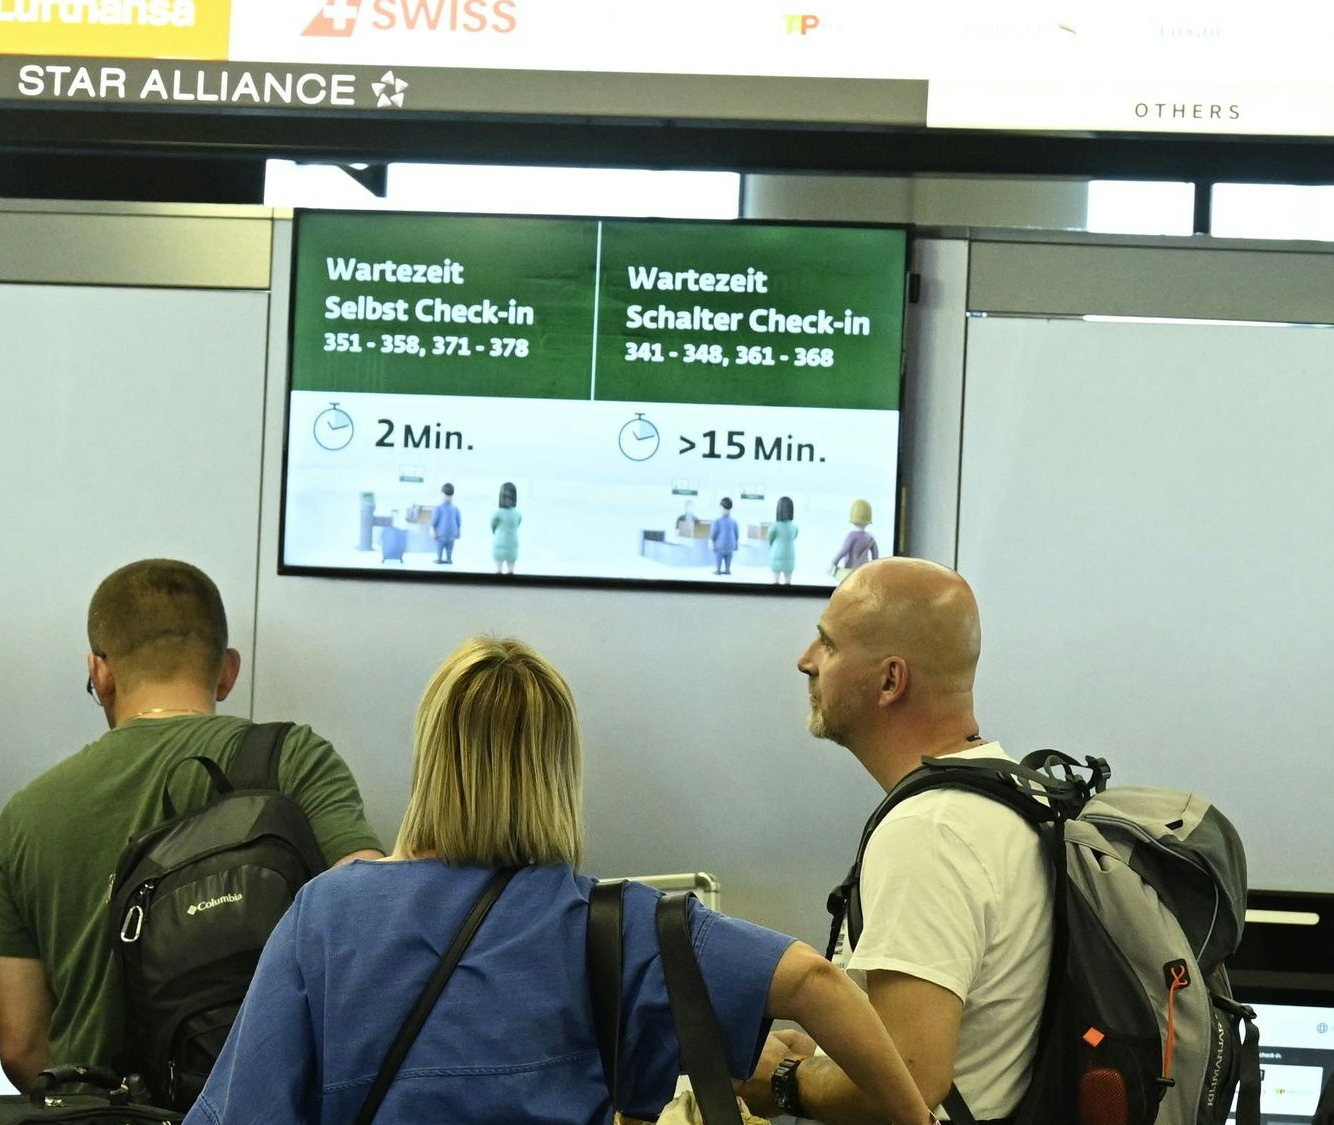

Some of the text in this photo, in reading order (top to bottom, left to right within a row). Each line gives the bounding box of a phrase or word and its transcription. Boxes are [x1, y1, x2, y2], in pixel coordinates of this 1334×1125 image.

[371, 0, 517, 33] SWISS
[18, 65, 355, 105] STAR ALLIANCE
[1134, 102, 1242, 120] OTHERS
[326, 257, 464, 285] Wartezeit
[628, 266, 768, 293] Wartezeit
[324, 296, 534, 325] Selbst Check-in
[625, 305, 870, 335] Schalter Check-in
[324, 333, 362, 352] 351
[381, 335, 426, 357] 358,
[432, 336, 471, 356] 371
[490, 338, 529, 357] 378
[625, 342, 664, 362] 341
[683, 344, 729, 367] 348,
[736, 346, 775, 365] 361
[794, 348, 834, 367] 368
[375, 419, 474, 451] 2 Min.
[754, 435, 827, 463] Min.
[196, 892, 244, 912] Columbia
